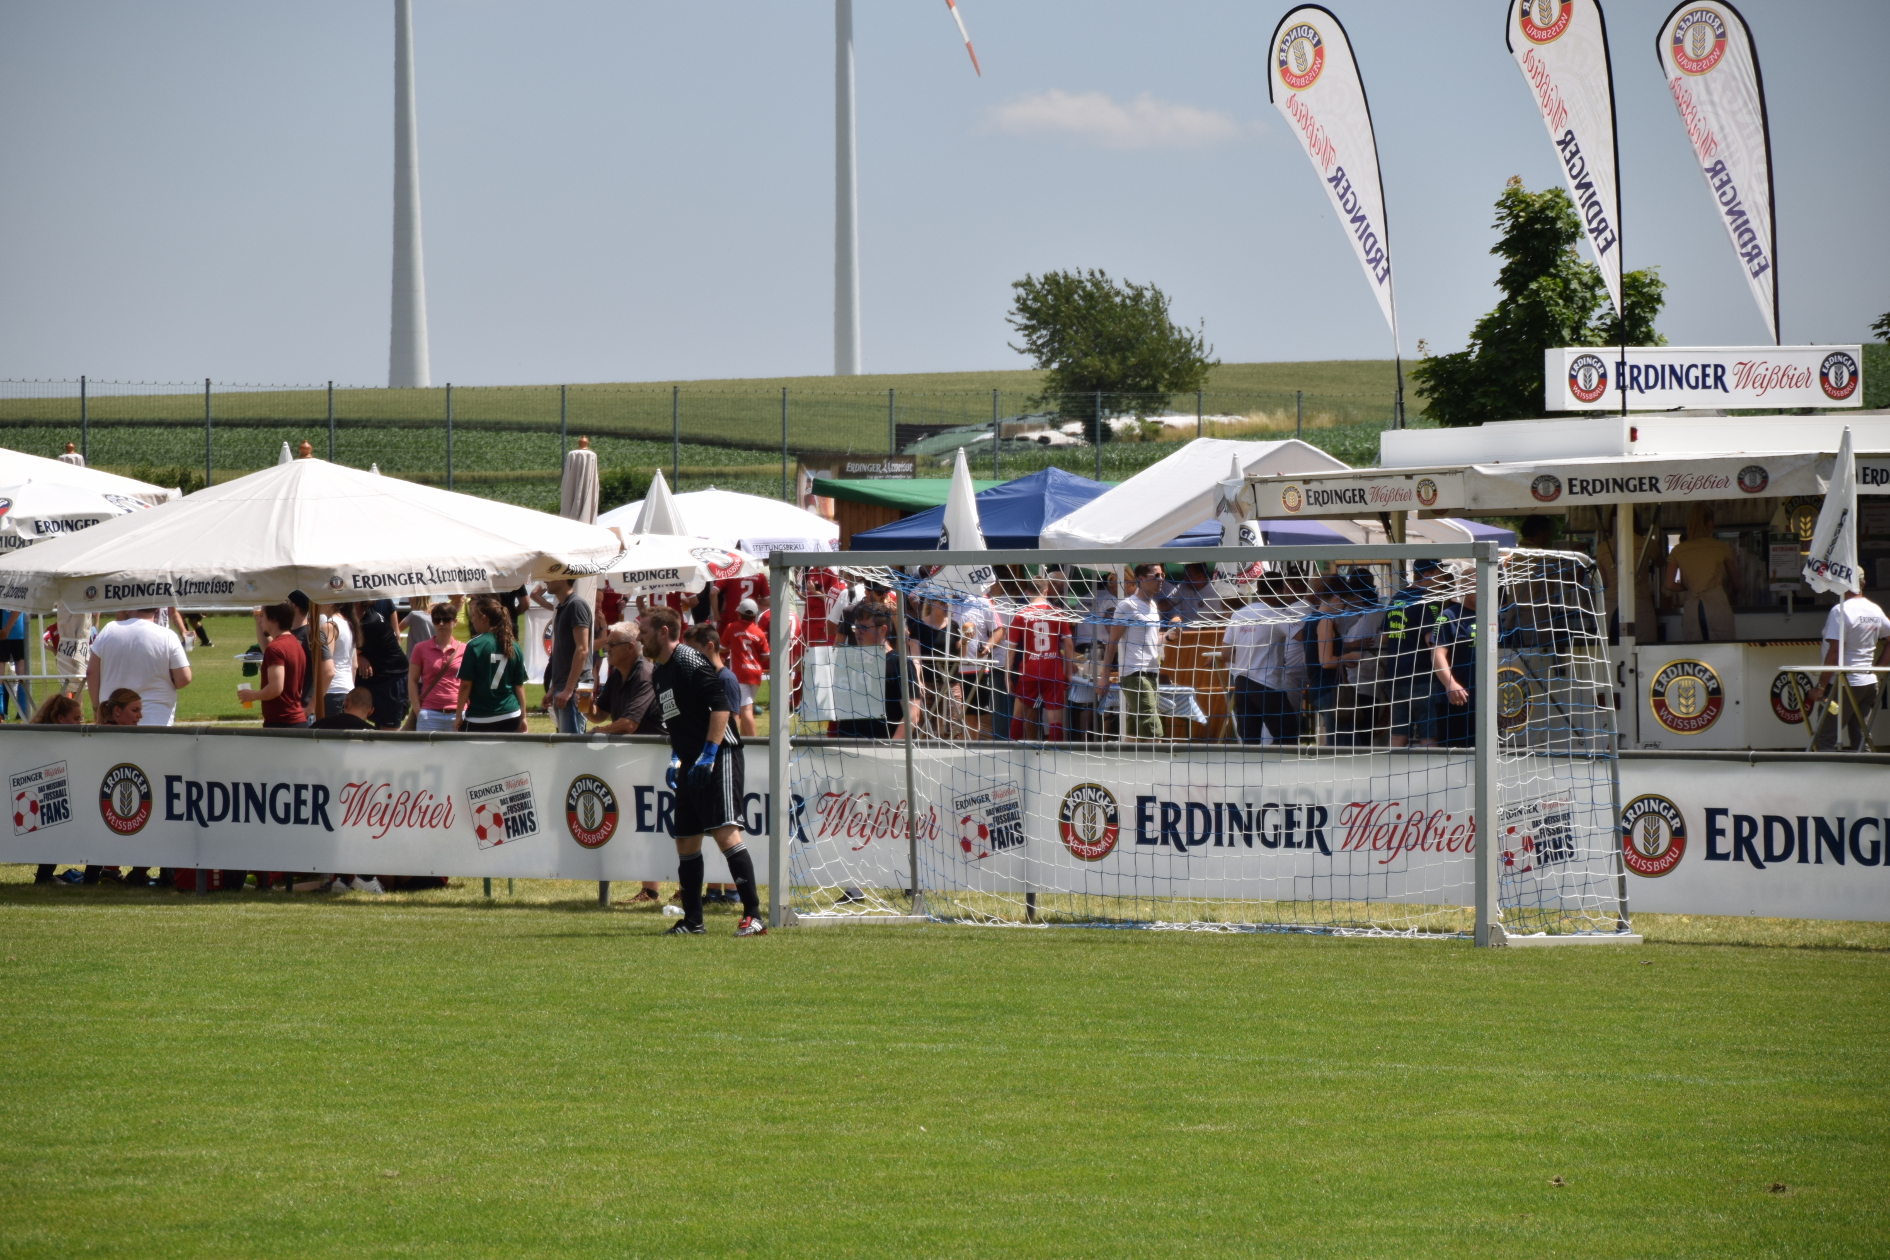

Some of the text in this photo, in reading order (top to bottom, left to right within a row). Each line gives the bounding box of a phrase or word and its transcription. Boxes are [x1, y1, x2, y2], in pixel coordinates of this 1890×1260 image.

[1571, 356, 1605, 376] ERDINGER
[1822, 354, 1856, 374] ERDINGER
[1615, 359, 1814, 397] ERDINGER Weißbier
[846, 462, 881, 473] ERDINGER
[1567, 473, 1731, 496] ERDINGER Weißbier
[1305, 488, 1368, 507] ERDINGER
[1368, 486, 1413, 506] Weißbier
[104, 582, 173, 600] ERDINGER
[172, 575, 235, 597] Urweisse
[352, 571, 427, 590] ERDINGER
[426, 564, 488, 585] Urweisse
[622, 568, 680, 584] ERDINGER
[740, 580, 754, 600] 2
[1032, 621, 1050, 652] 8
[743, 638, 754, 661] 5
[490, 653, 509, 690] 7
[1654, 663, 1718, 693] ERDINGER
[1773, 672, 1812, 694] ERDGER
[12, 771, 44, 788] ERDINGER
[38, 779, 67, 794] DAS WEISSBIER
[103, 767, 149, 796] ERDINGER
[43, 788, 68, 803] FUSSBALL
[469, 783, 505, 800] ERDINGER
[508, 790, 532, 804] WEISSBIER
[569, 779, 613, 808] ERDINGER
[955, 794, 992, 811] ERDINGER
[1063, 787, 1116, 818] ERDINGER
[40, 799, 70, 826] FANS
[165, 775, 456, 840] ERDINGER Weißbier
[507, 799, 533, 815] FUSSBALL
[992, 811, 1021, 826] FUSSBALL
[1621, 799, 1682, 832] ERDINGER
[504, 811, 537, 839] FANS
[989, 822, 1025, 850] FANS
[1136, 795, 1476, 865] ERDINGER Weißbier
[1535, 834, 1575, 866] FANS
